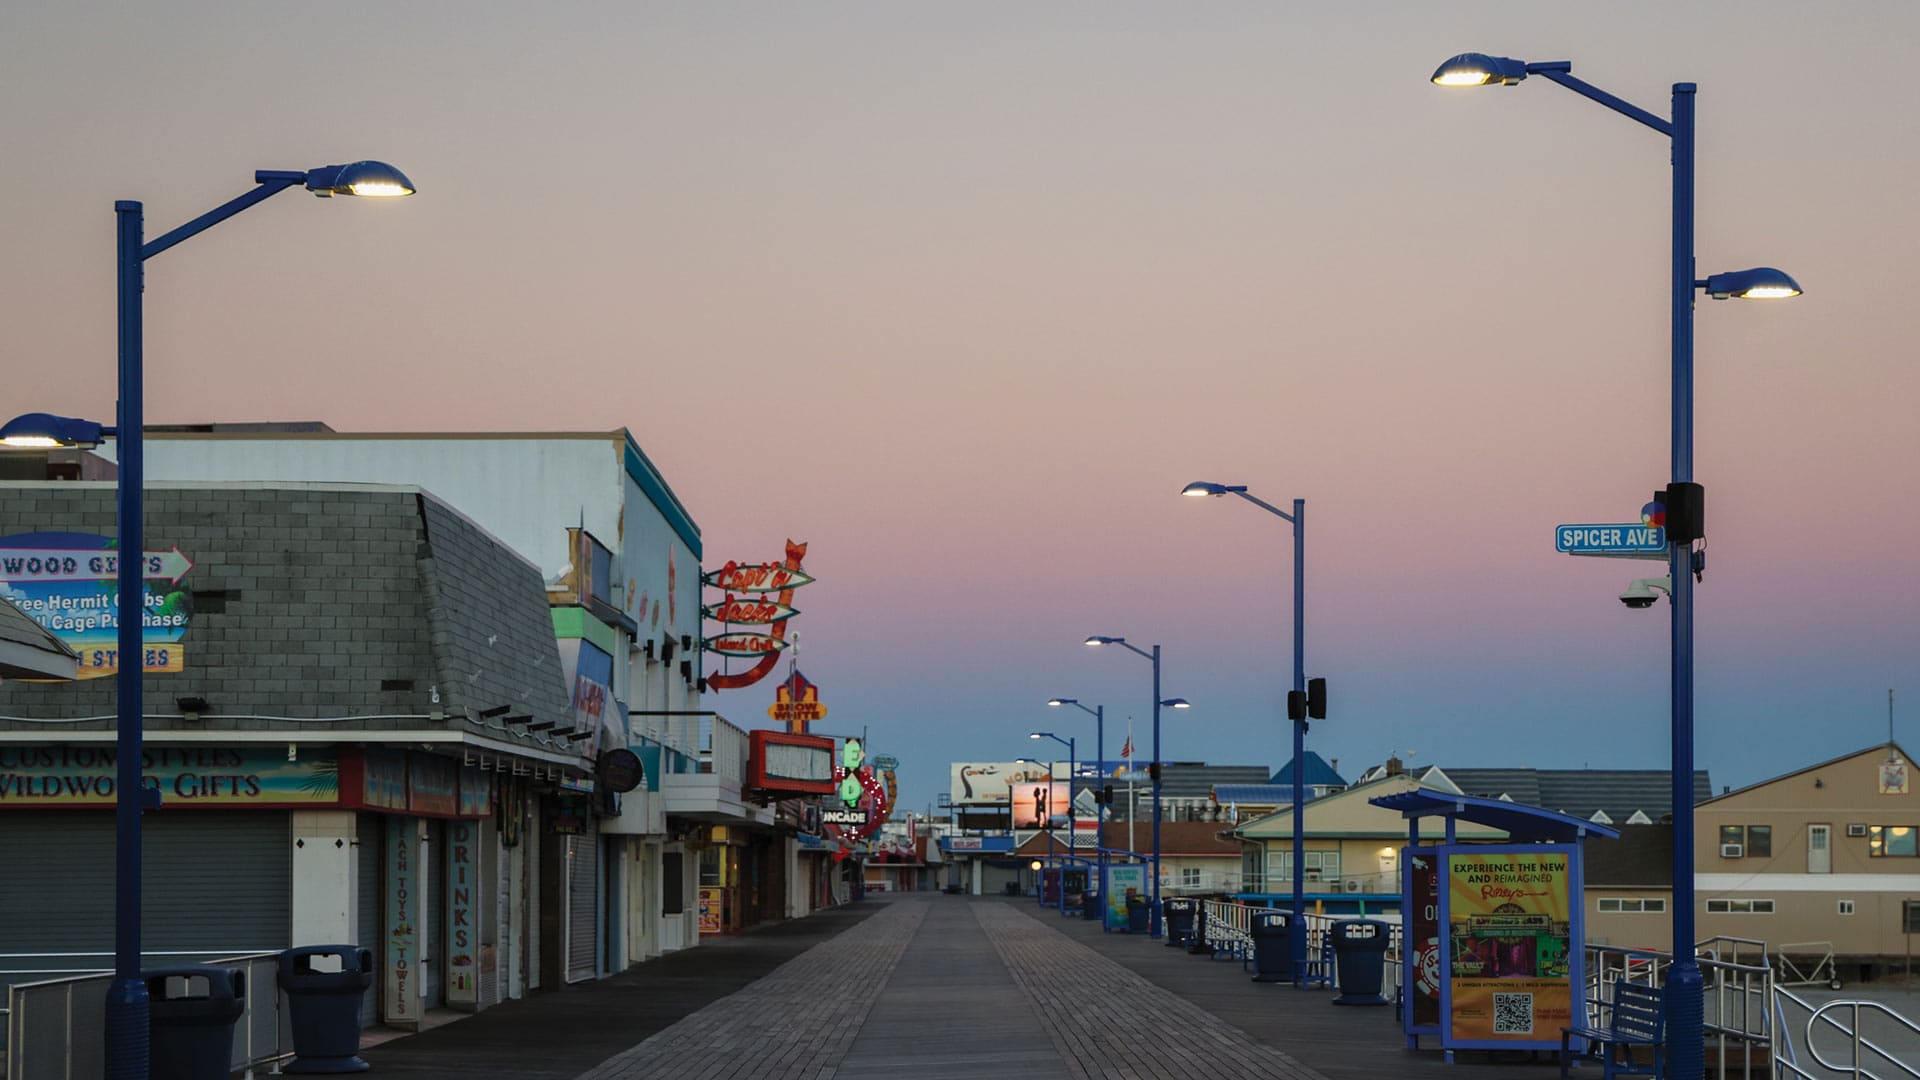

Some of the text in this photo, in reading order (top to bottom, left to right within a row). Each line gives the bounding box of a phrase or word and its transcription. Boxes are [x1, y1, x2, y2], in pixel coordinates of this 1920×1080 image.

[1563, 528, 1658, 547] SPICER AVE
[0, 556, 162, 575] WOOD GIS
[48, 594, 109, 610] Hermit
[52, 616, 96, 632] Cage
[101, 614, 183, 629] Puhase
[93, 650, 169, 667] STES
[774, 711, 820, 720] WHITE
[776, 703, 818, 711] SNOW
[142, 747, 244, 768] STYLES
[174, 773, 260, 798] GIFTS
[1454, 863, 1565, 873] EXPERIENCE THE NEW
[454, 824, 470, 947] DRINKS
[1468, 874, 1553, 883] AND REIMAGINED
[398, 877, 409, 921] TOYS
[396, 948, 409, 1014] TOWELS
